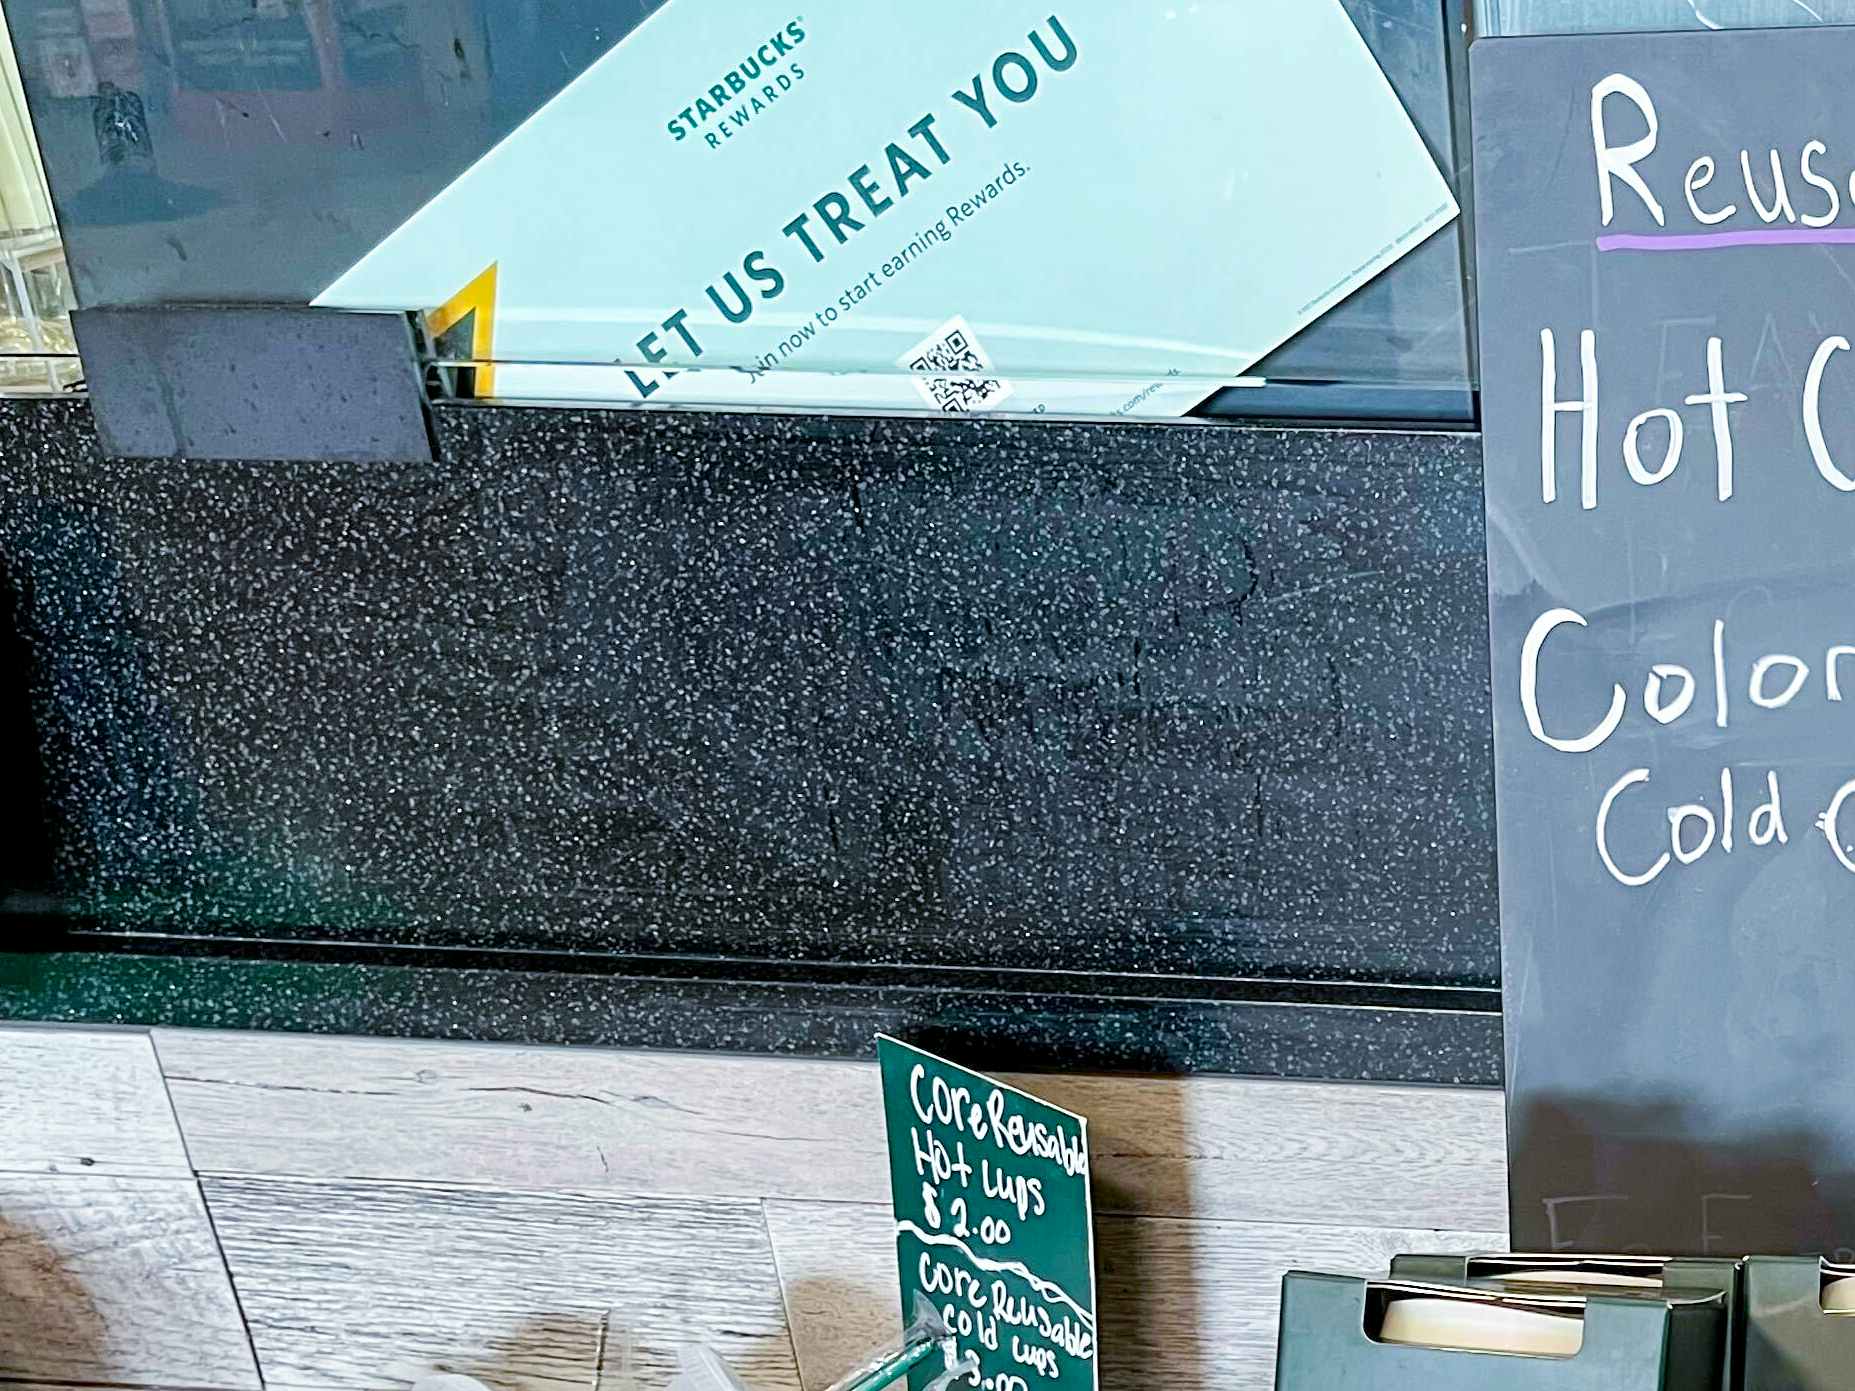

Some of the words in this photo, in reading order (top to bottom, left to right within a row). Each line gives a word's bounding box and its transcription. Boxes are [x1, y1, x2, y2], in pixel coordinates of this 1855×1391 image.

[667, 18, 806, 141] STARBUCKS
[704, 63, 804, 149] REWARDS
[705, 250, 785, 325] US
[782, 113, 951, 263] TREAT
[951, 15, 1078, 129] YOU
[779, 322, 816, 359] now
[816, 306, 838, 327] to
[838, 271, 883, 312] start
[882, 221, 952, 278] earning
[945, 159, 1032, 226] Rewards.
[1540, 329, 1749, 510] Hot
[1596, 766, 1789, 888] Cold
[911, 1126, 972, 1187] Hot
